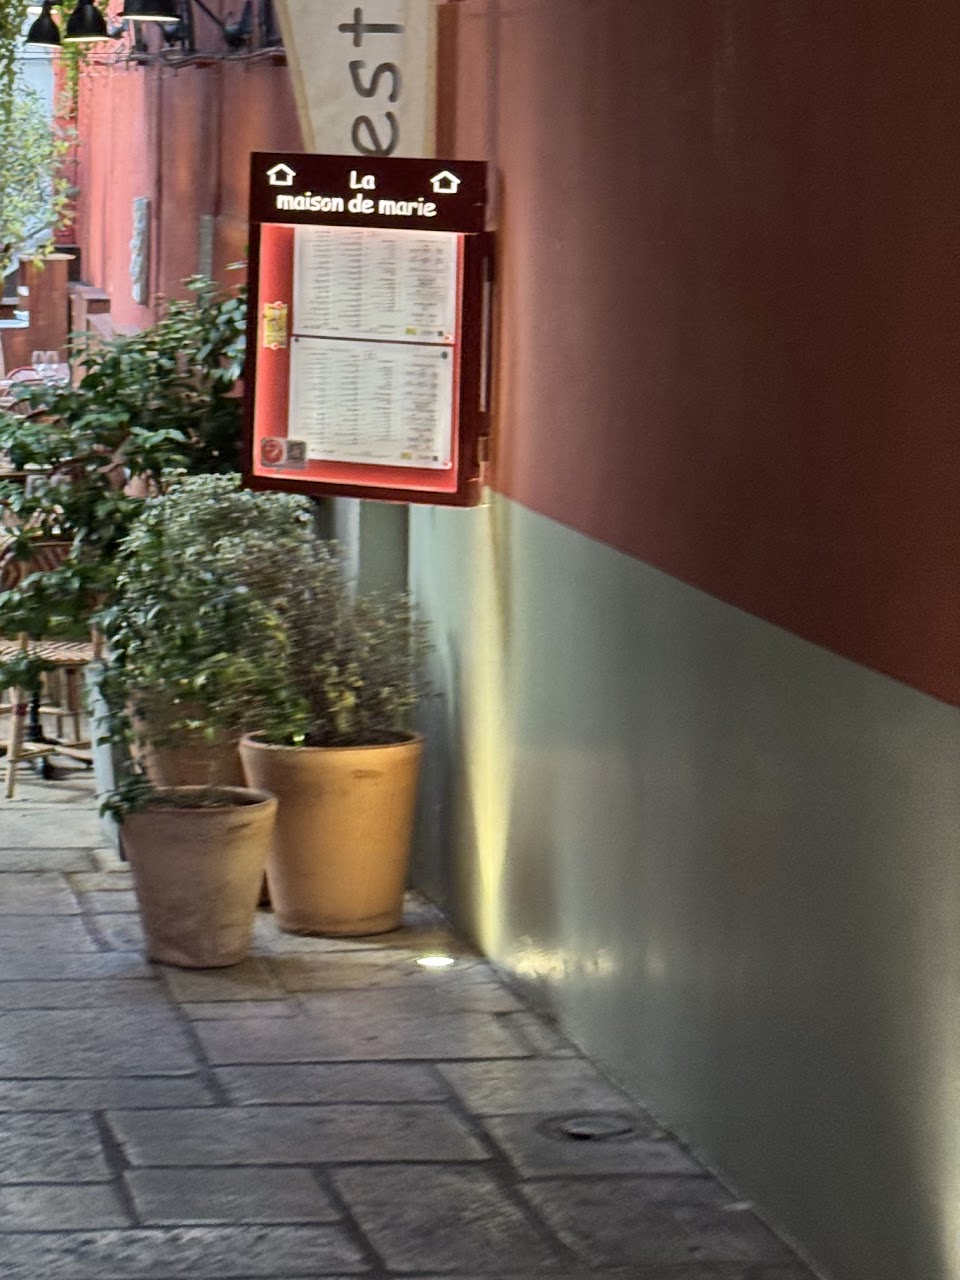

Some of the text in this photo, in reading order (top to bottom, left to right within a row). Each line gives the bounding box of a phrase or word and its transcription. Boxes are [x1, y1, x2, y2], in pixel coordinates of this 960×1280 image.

[350, 170, 376, 190] La
[276, 192, 438, 218] maison de marie
